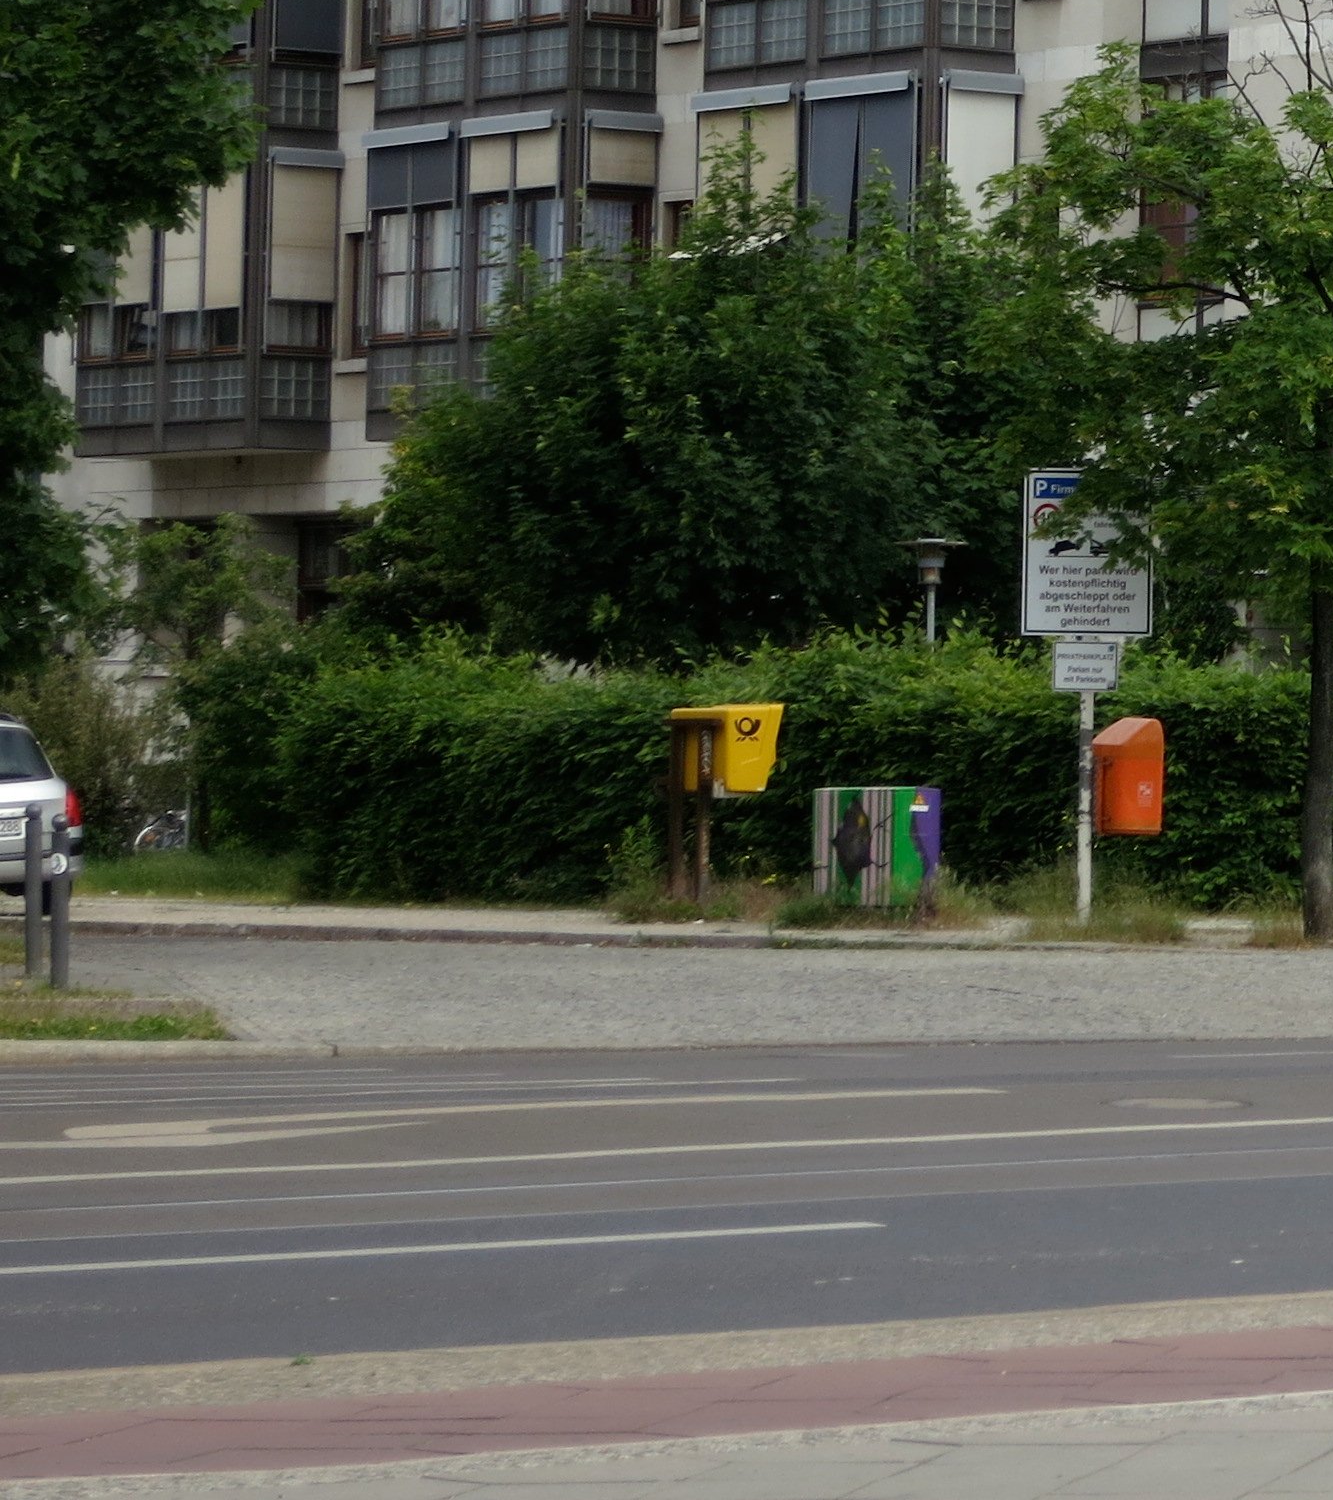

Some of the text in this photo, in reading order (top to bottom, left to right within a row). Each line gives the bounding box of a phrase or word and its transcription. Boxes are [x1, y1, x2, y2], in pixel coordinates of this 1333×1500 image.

[1040, 565, 1058, 575] Wer
[1063, 565, 1082, 575] hier
[1049, 578, 1127, 590] kostenpflichtig
[1040, 591, 1136, 602] abgeschleppt oder
[1045, 604, 1130, 614] am Weiterfahren
[1061, 616, 1110, 627] gehindert
